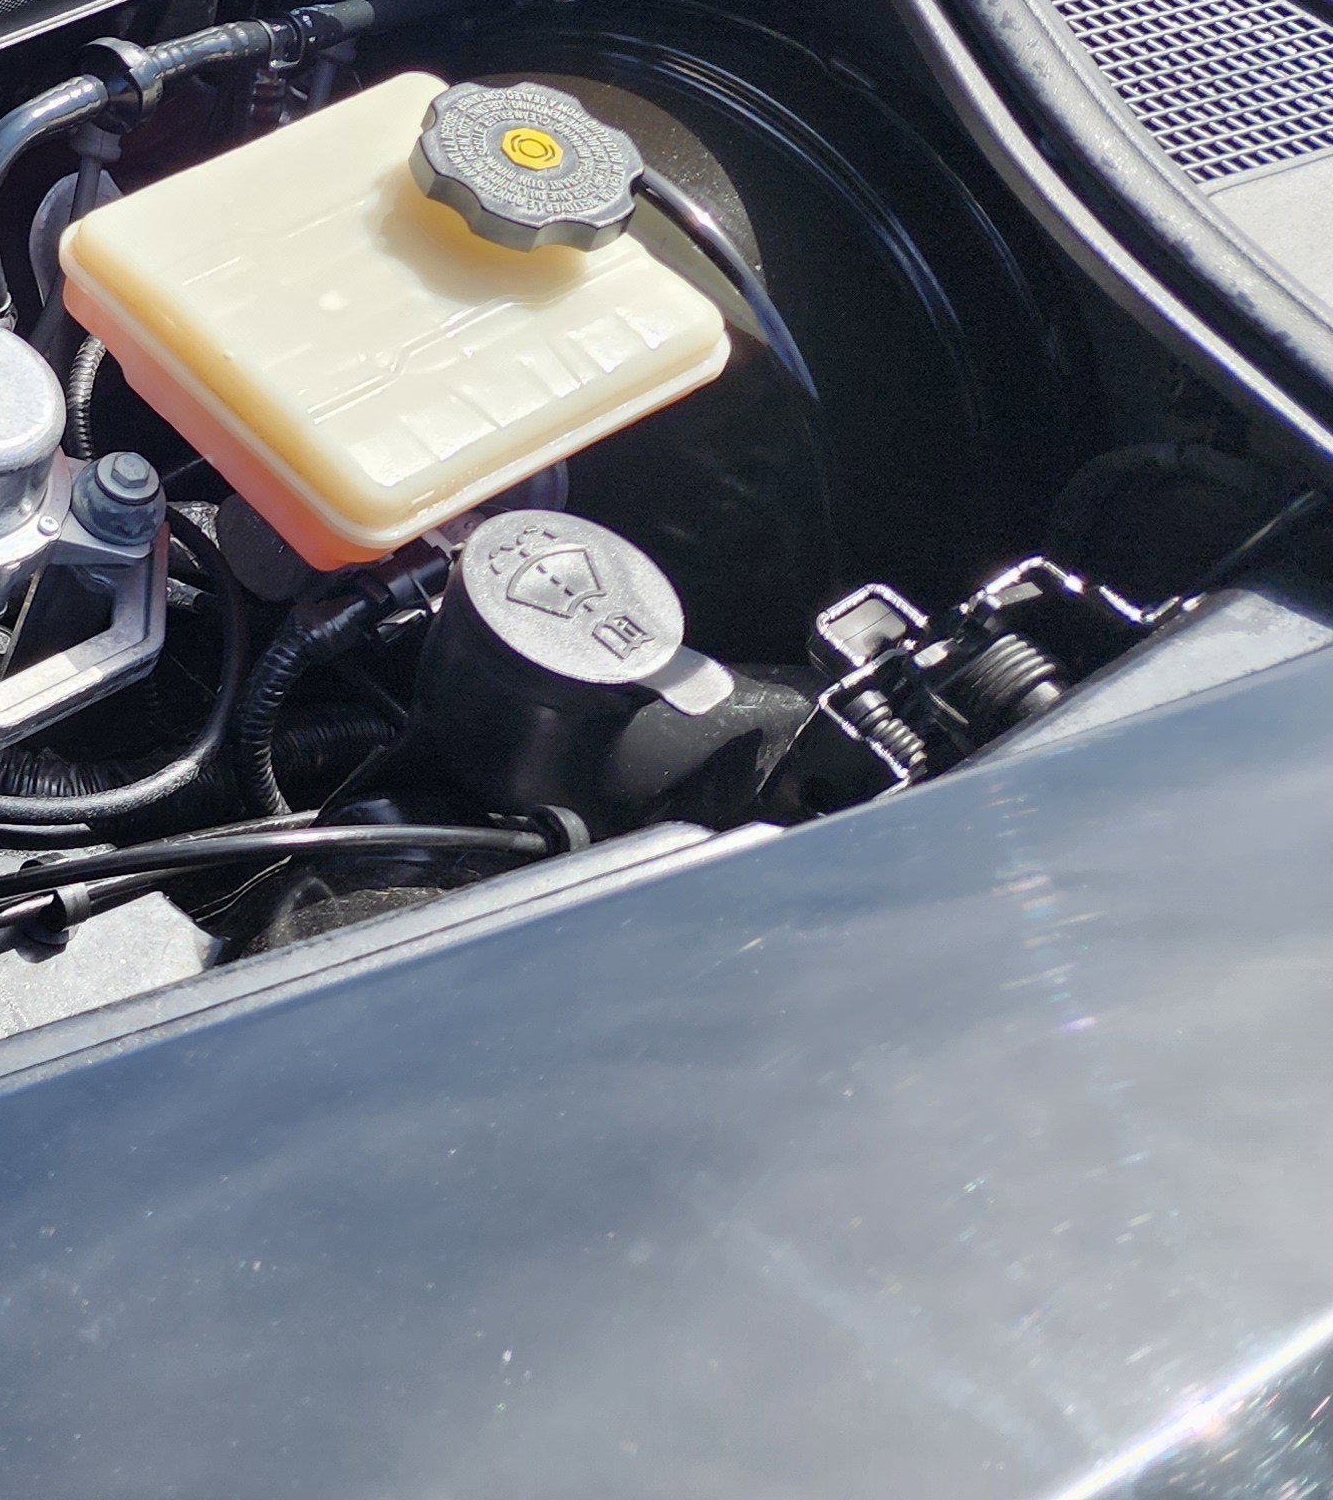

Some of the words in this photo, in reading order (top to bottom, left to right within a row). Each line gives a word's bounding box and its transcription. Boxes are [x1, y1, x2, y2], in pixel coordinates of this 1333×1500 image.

[453, 90, 508, 113] CONTAINER
[505, 90, 548, 106] SEALED
[513, 111, 551, 127] CLEAN
[557, 102, 591, 124] FROM
[562, 117, 601, 146] BEFORE
[584, 121, 613, 142] FLUID
[444, 152, 475, 179] AVANT
[466, 161, 485, 174] DE
[478, 156, 516, 183] BIDON
[468, 177, 524, 208] BOUCHON
[478, 171, 526, 199] LIQUIDE
[529, 192, 547, 202] DU
[547, 192, 577, 203] QUE
